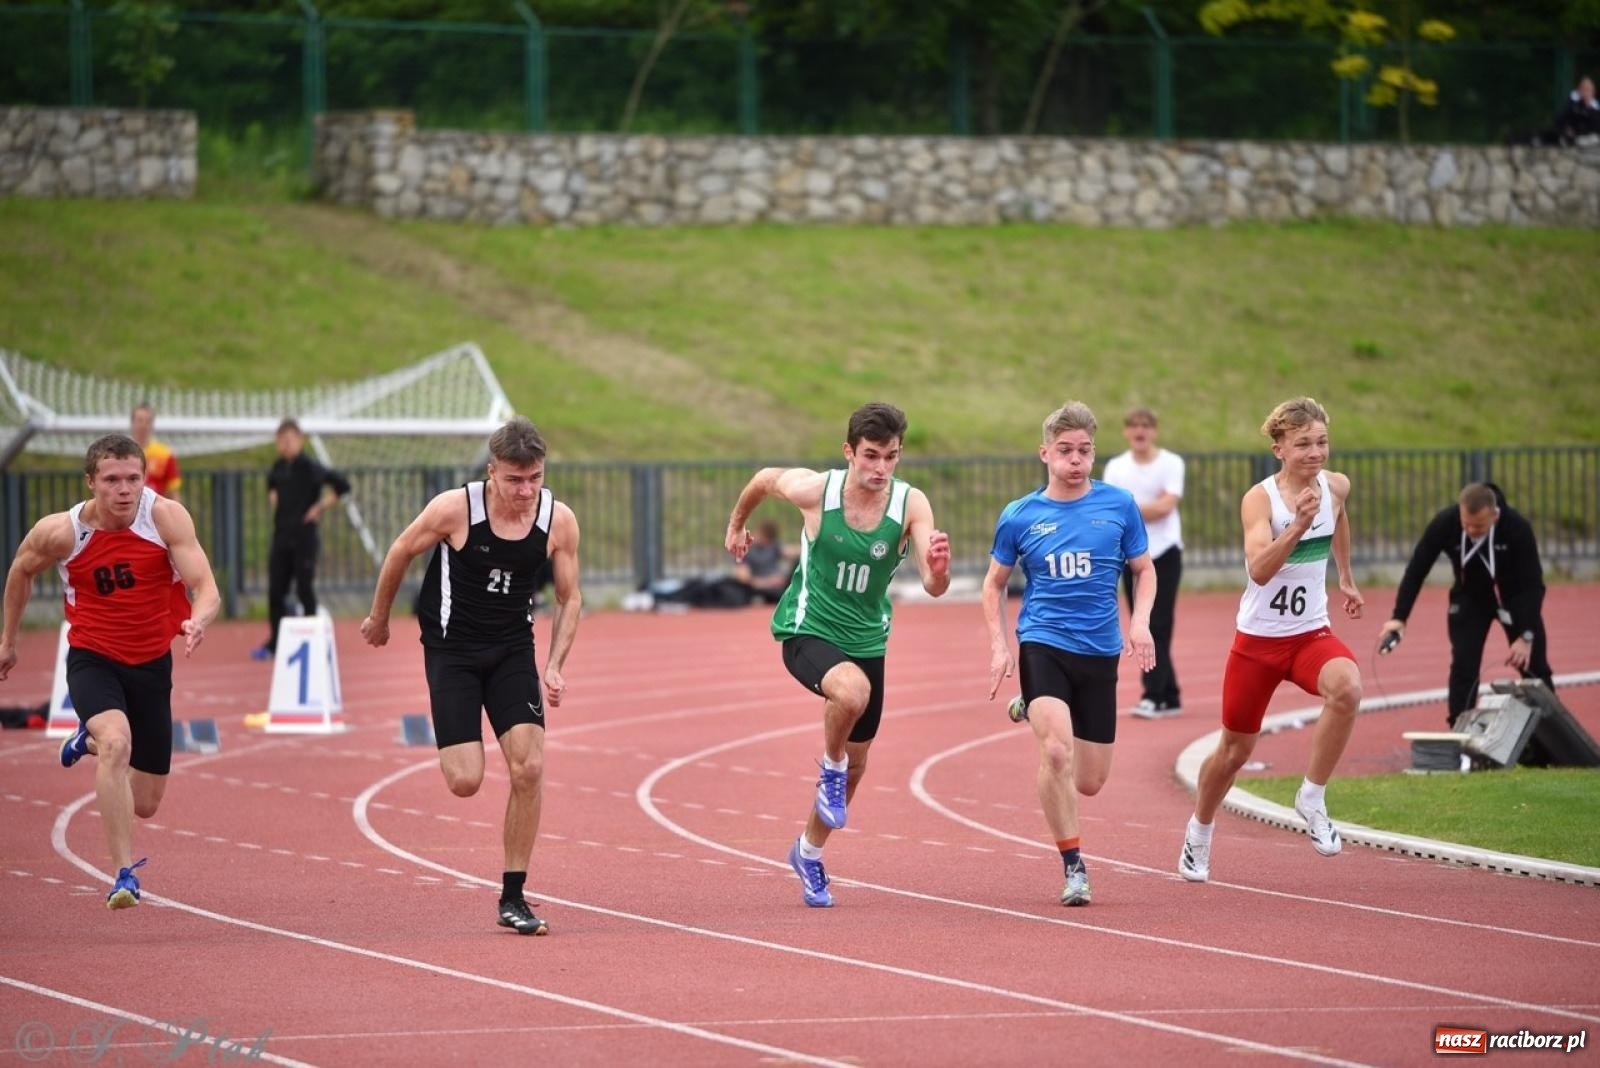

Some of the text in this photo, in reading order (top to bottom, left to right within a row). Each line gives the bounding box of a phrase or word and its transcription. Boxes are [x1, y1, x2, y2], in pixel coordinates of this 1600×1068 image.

[94, 563, 136, 596] 85
[487, 568, 512, 595] 21
[836, 561, 871, 594] 110
[1044, 552, 1092, 579] 105
[1270, 585, 1306, 616] 46
[287, 640, 310, 705] 1
